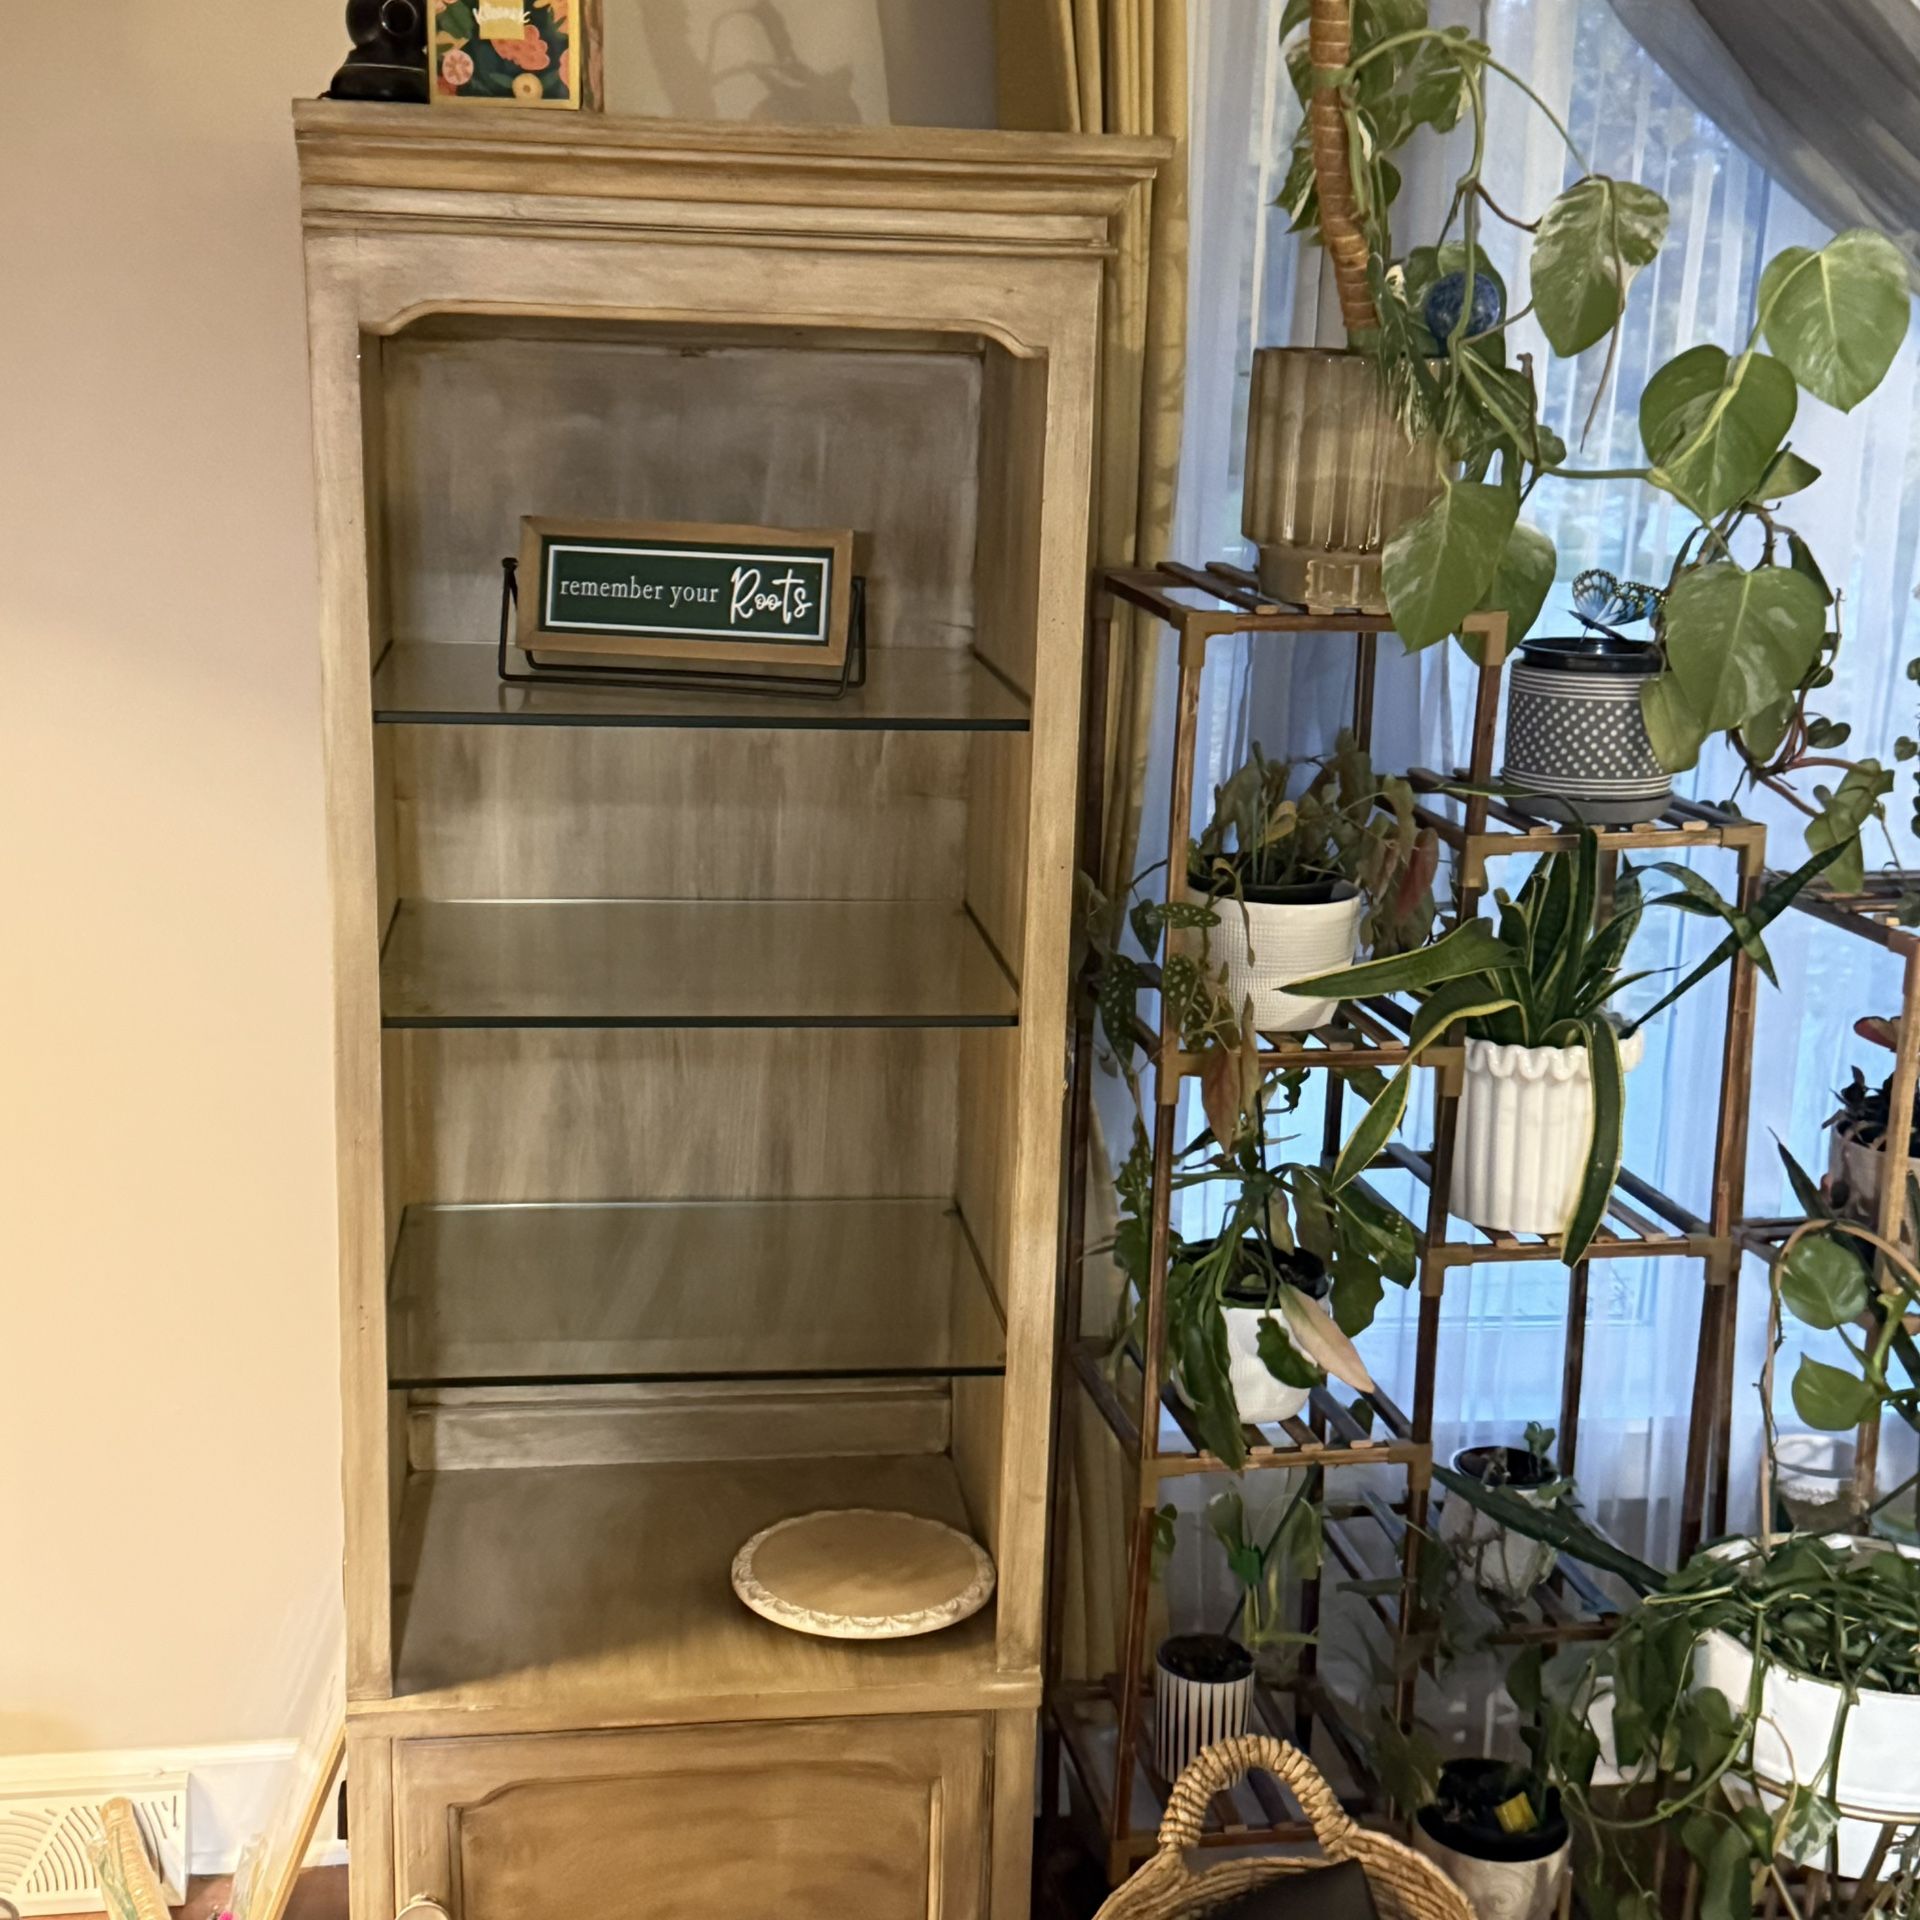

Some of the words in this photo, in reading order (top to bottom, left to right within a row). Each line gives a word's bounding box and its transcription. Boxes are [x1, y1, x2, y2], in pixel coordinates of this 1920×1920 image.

[560, 576, 664, 600] remember
[670, 585, 720, 608] your
[731, 567, 812, 625] Roots
